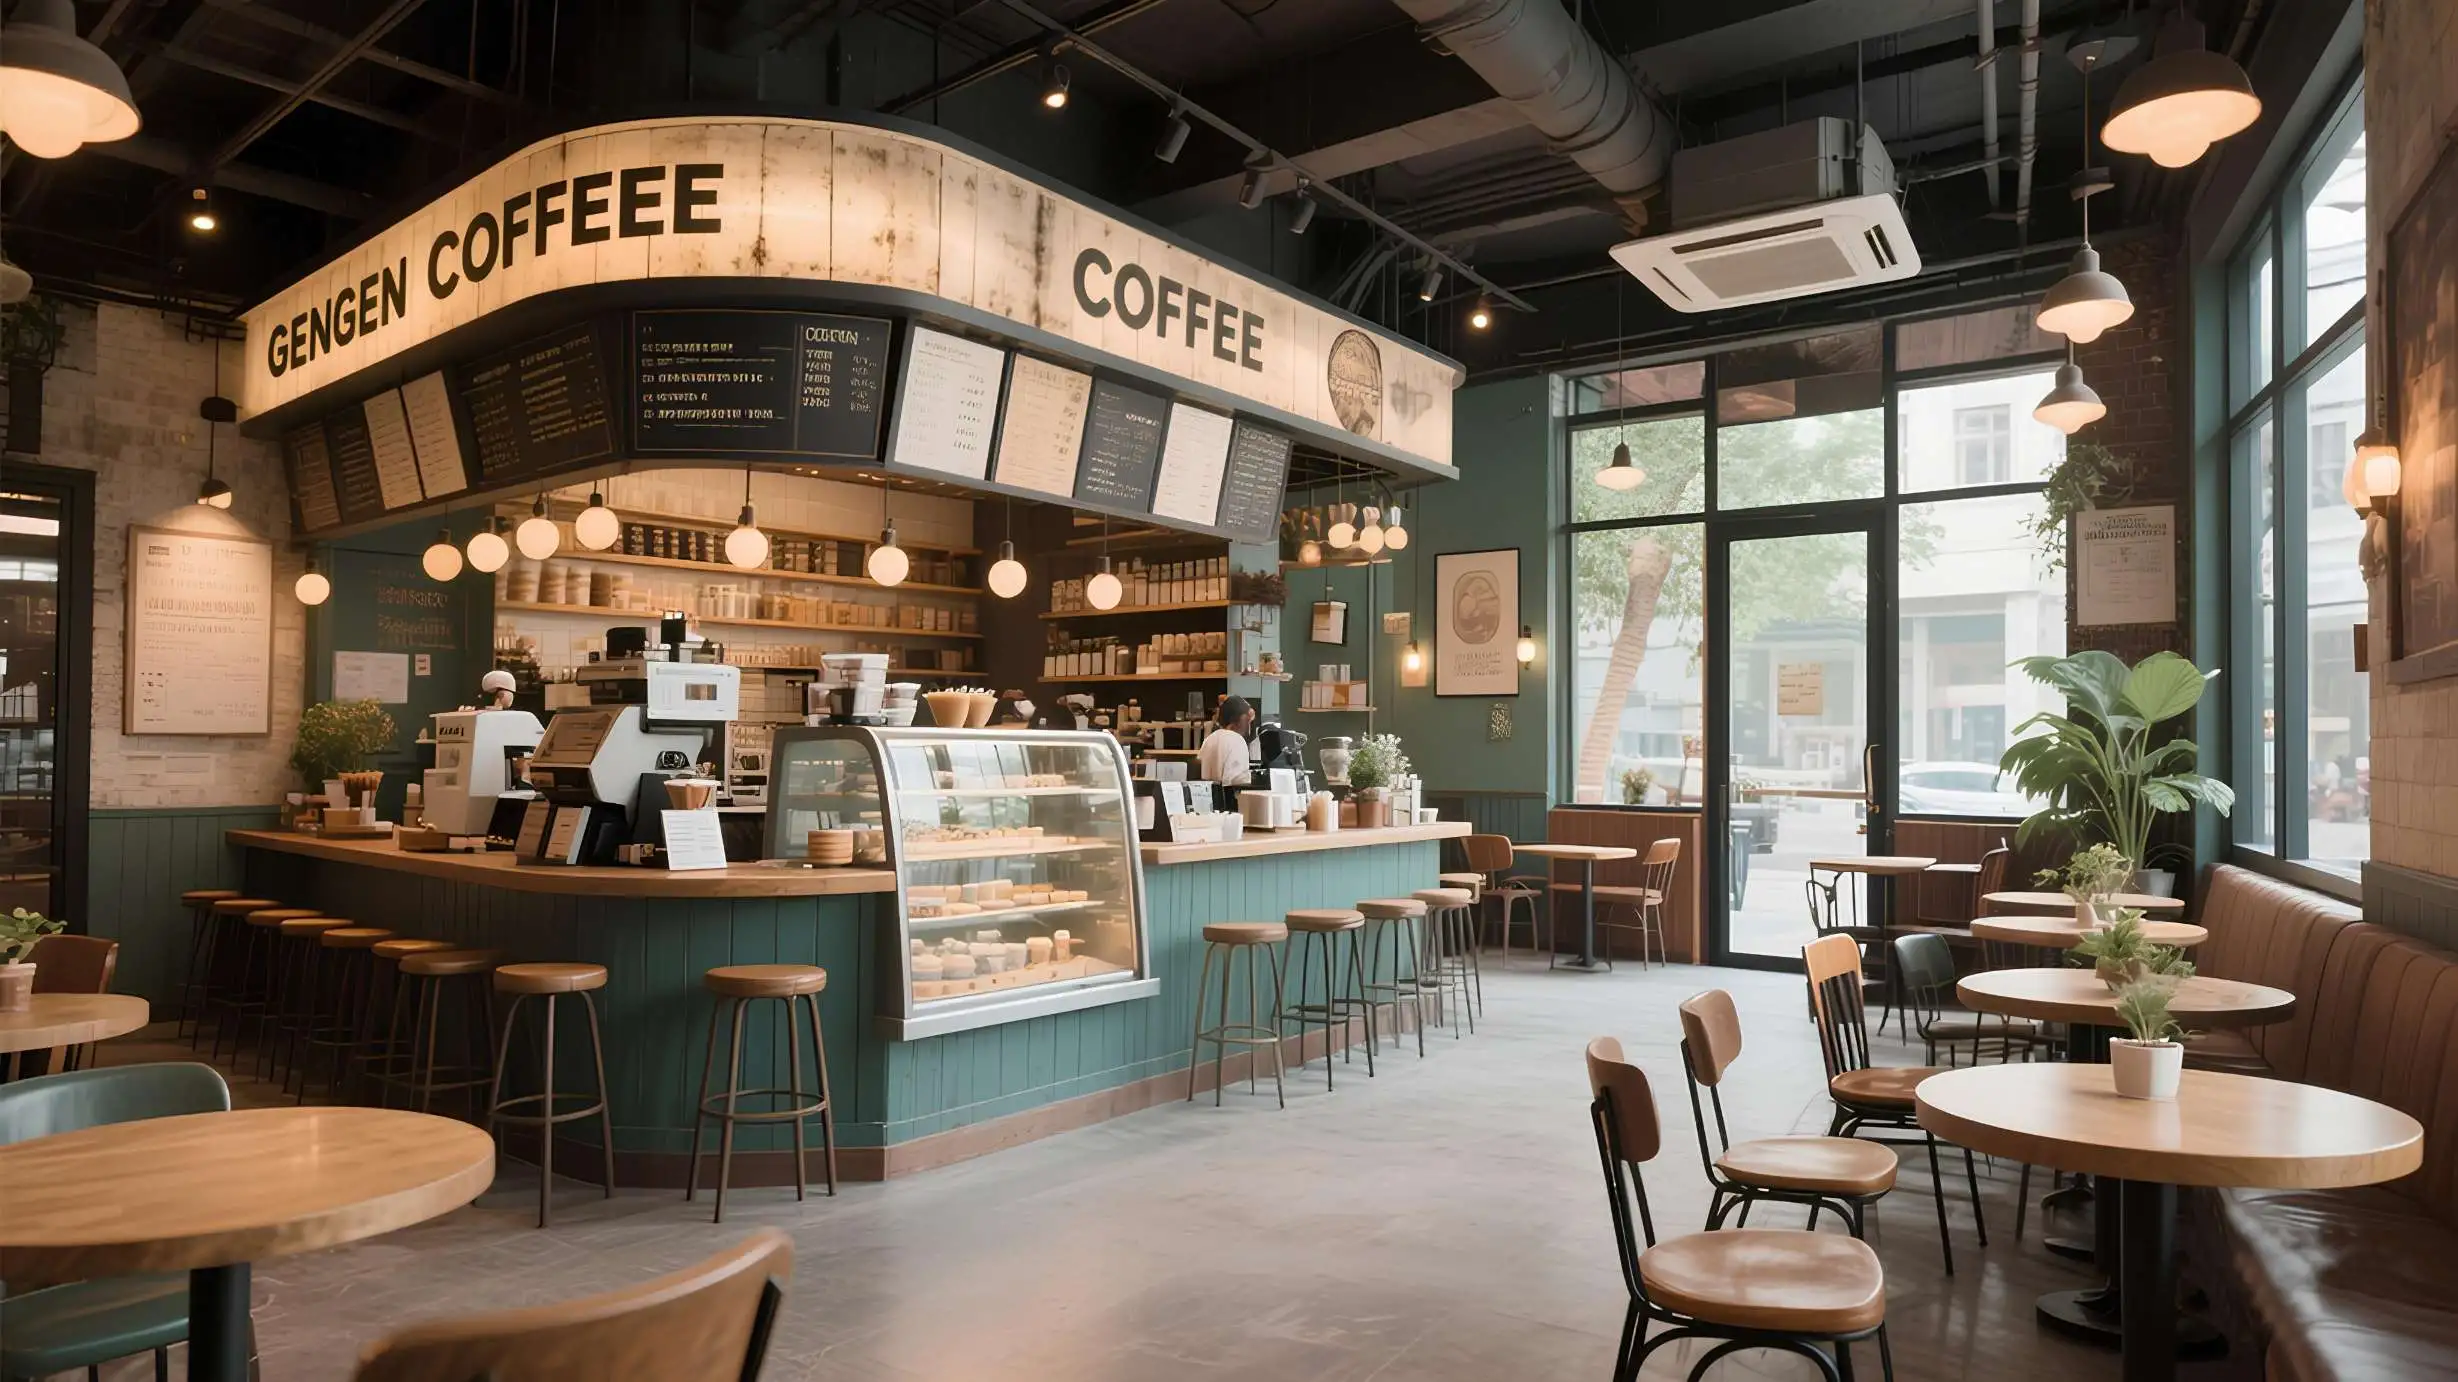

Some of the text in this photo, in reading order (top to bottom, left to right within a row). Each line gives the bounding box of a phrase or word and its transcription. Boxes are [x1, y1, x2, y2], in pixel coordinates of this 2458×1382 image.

[267, 163, 725, 378] GENGEN COFFEEE
[1073, 247, 1265, 373] COFFEE
